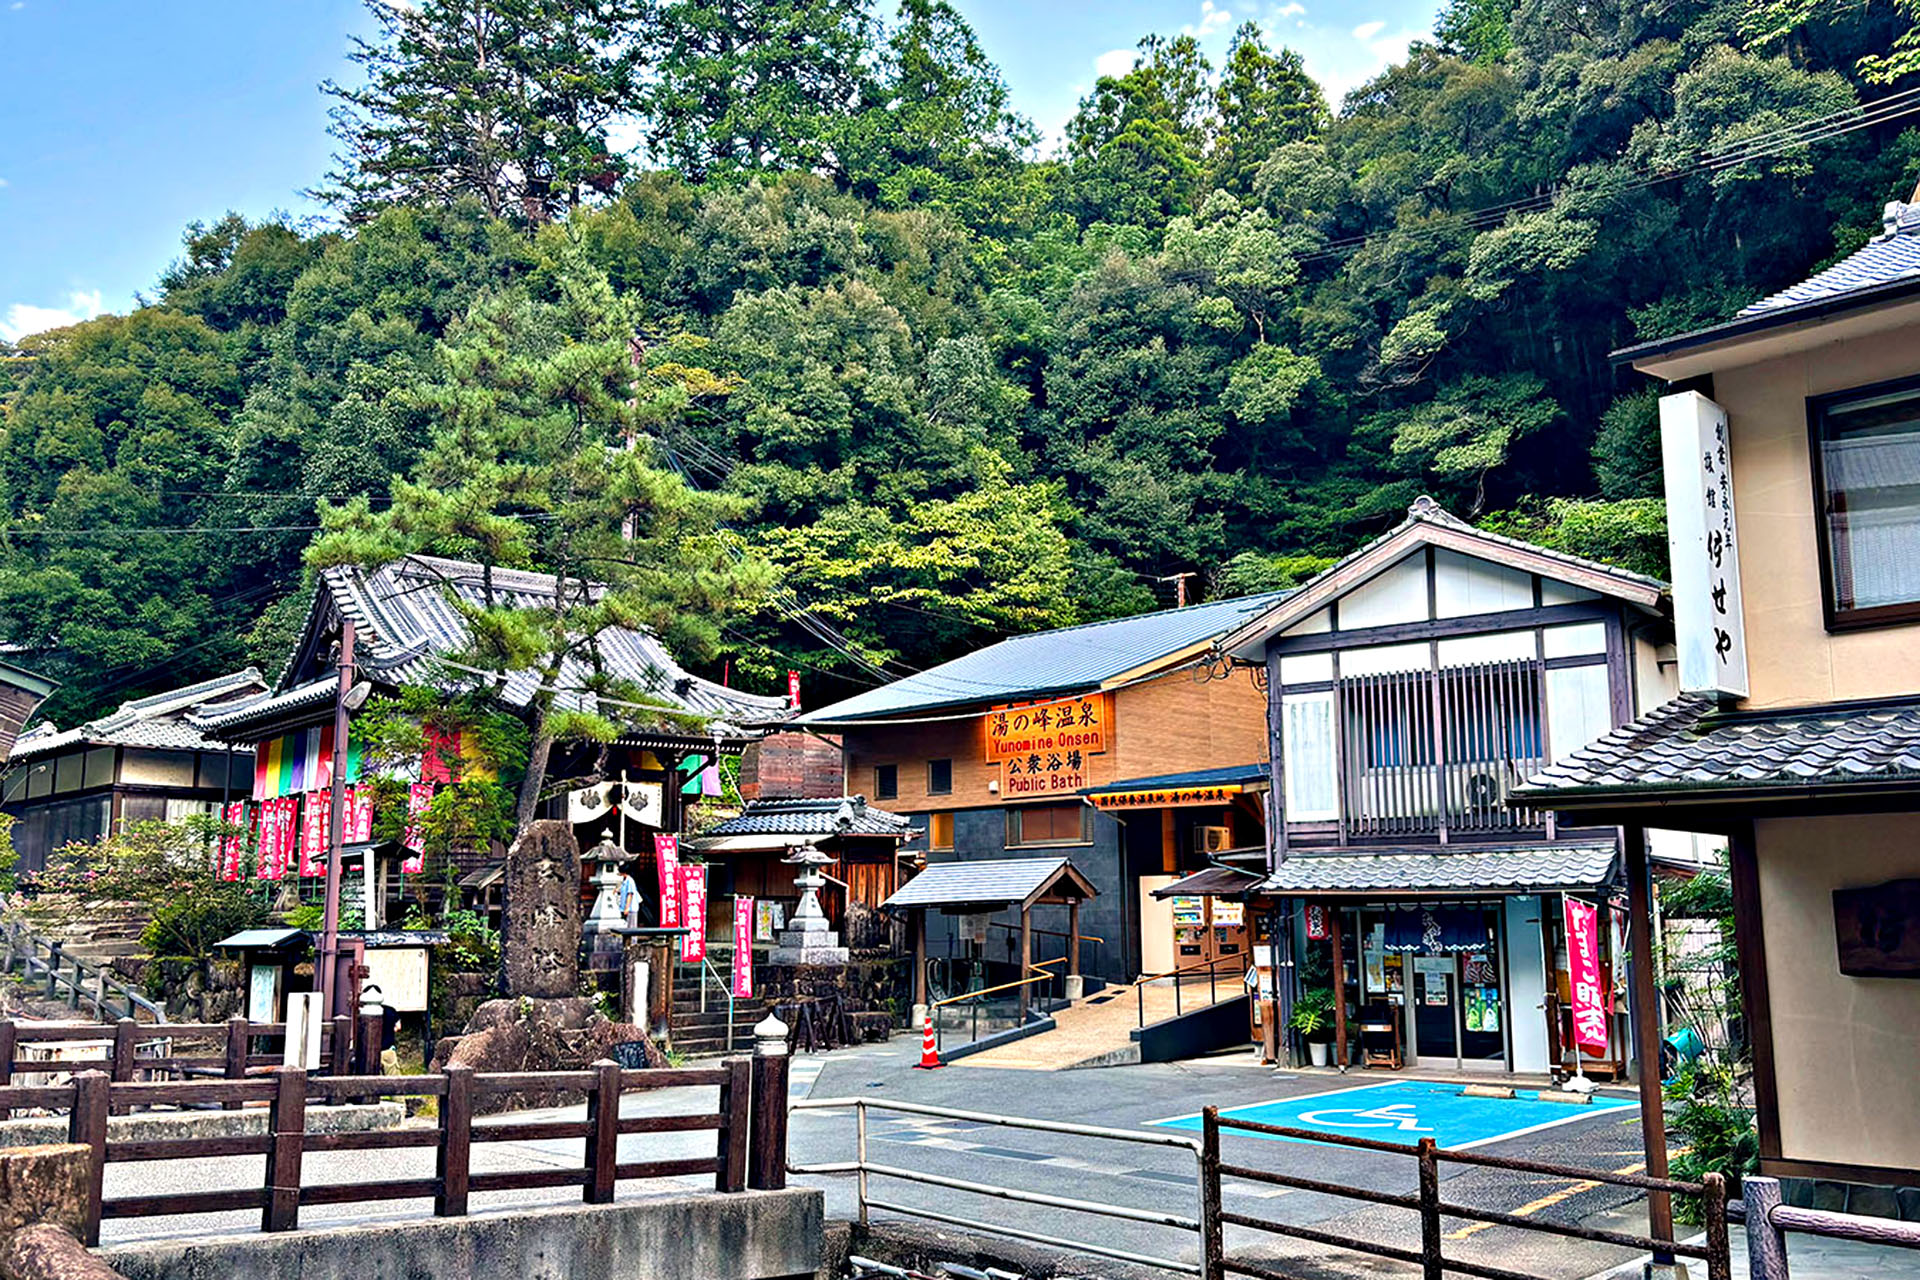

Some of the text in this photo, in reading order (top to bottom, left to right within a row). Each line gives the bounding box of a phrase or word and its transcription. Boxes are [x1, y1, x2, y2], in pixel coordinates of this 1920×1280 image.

[992, 702, 1098, 736] 湯の峰温泉
[994, 732, 1099, 753] Yunomine Onsen
[1007, 749, 1083, 775] 公衆浴場
[1009, 772, 1083, 792] Public Bath
[1170, 788, 1227, 803] 湯の峰温泉
